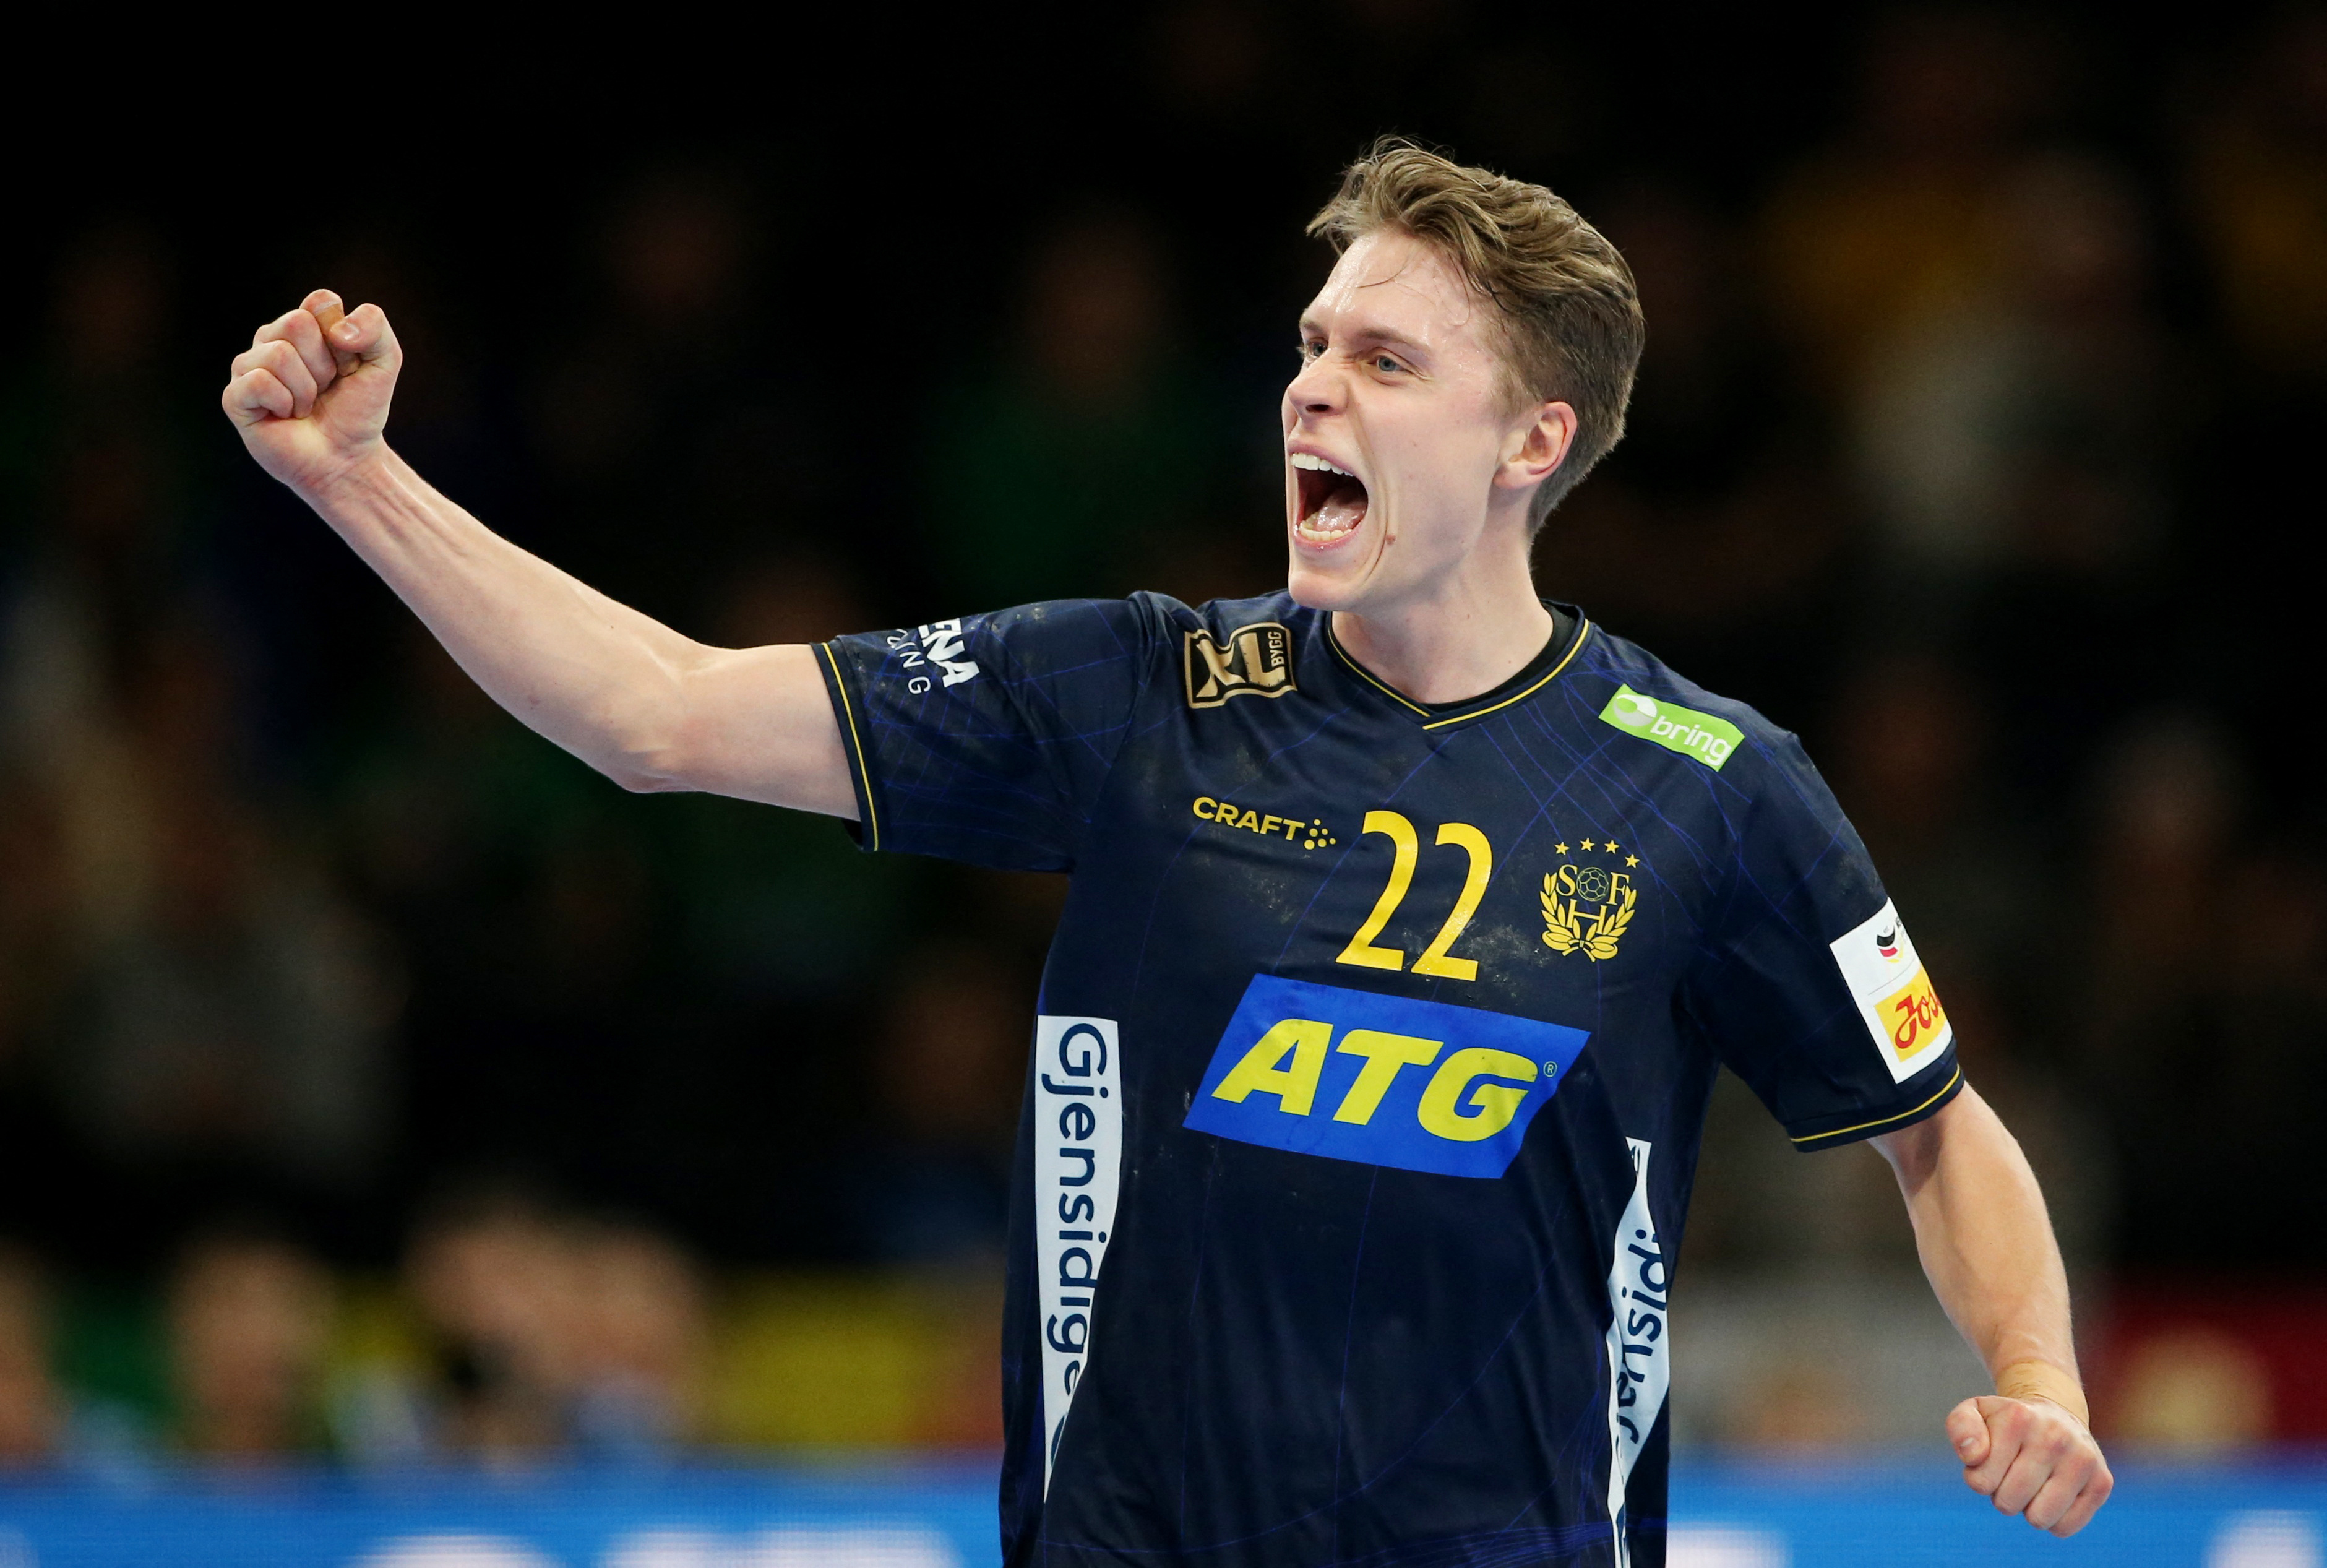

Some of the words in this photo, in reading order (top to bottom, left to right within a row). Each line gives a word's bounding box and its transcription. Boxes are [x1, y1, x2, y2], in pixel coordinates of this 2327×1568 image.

[1195, 632, 1286, 698] XL
[1268, 631, 1285, 668] BYGG
[1650, 715, 1732, 767] bring
[1192, 796, 1305, 841] CRAFT
[1335, 809, 1493, 981] 22
[1895, 985, 1942, 1049] Jos
[1211, 1018, 1539, 1142] ATG
